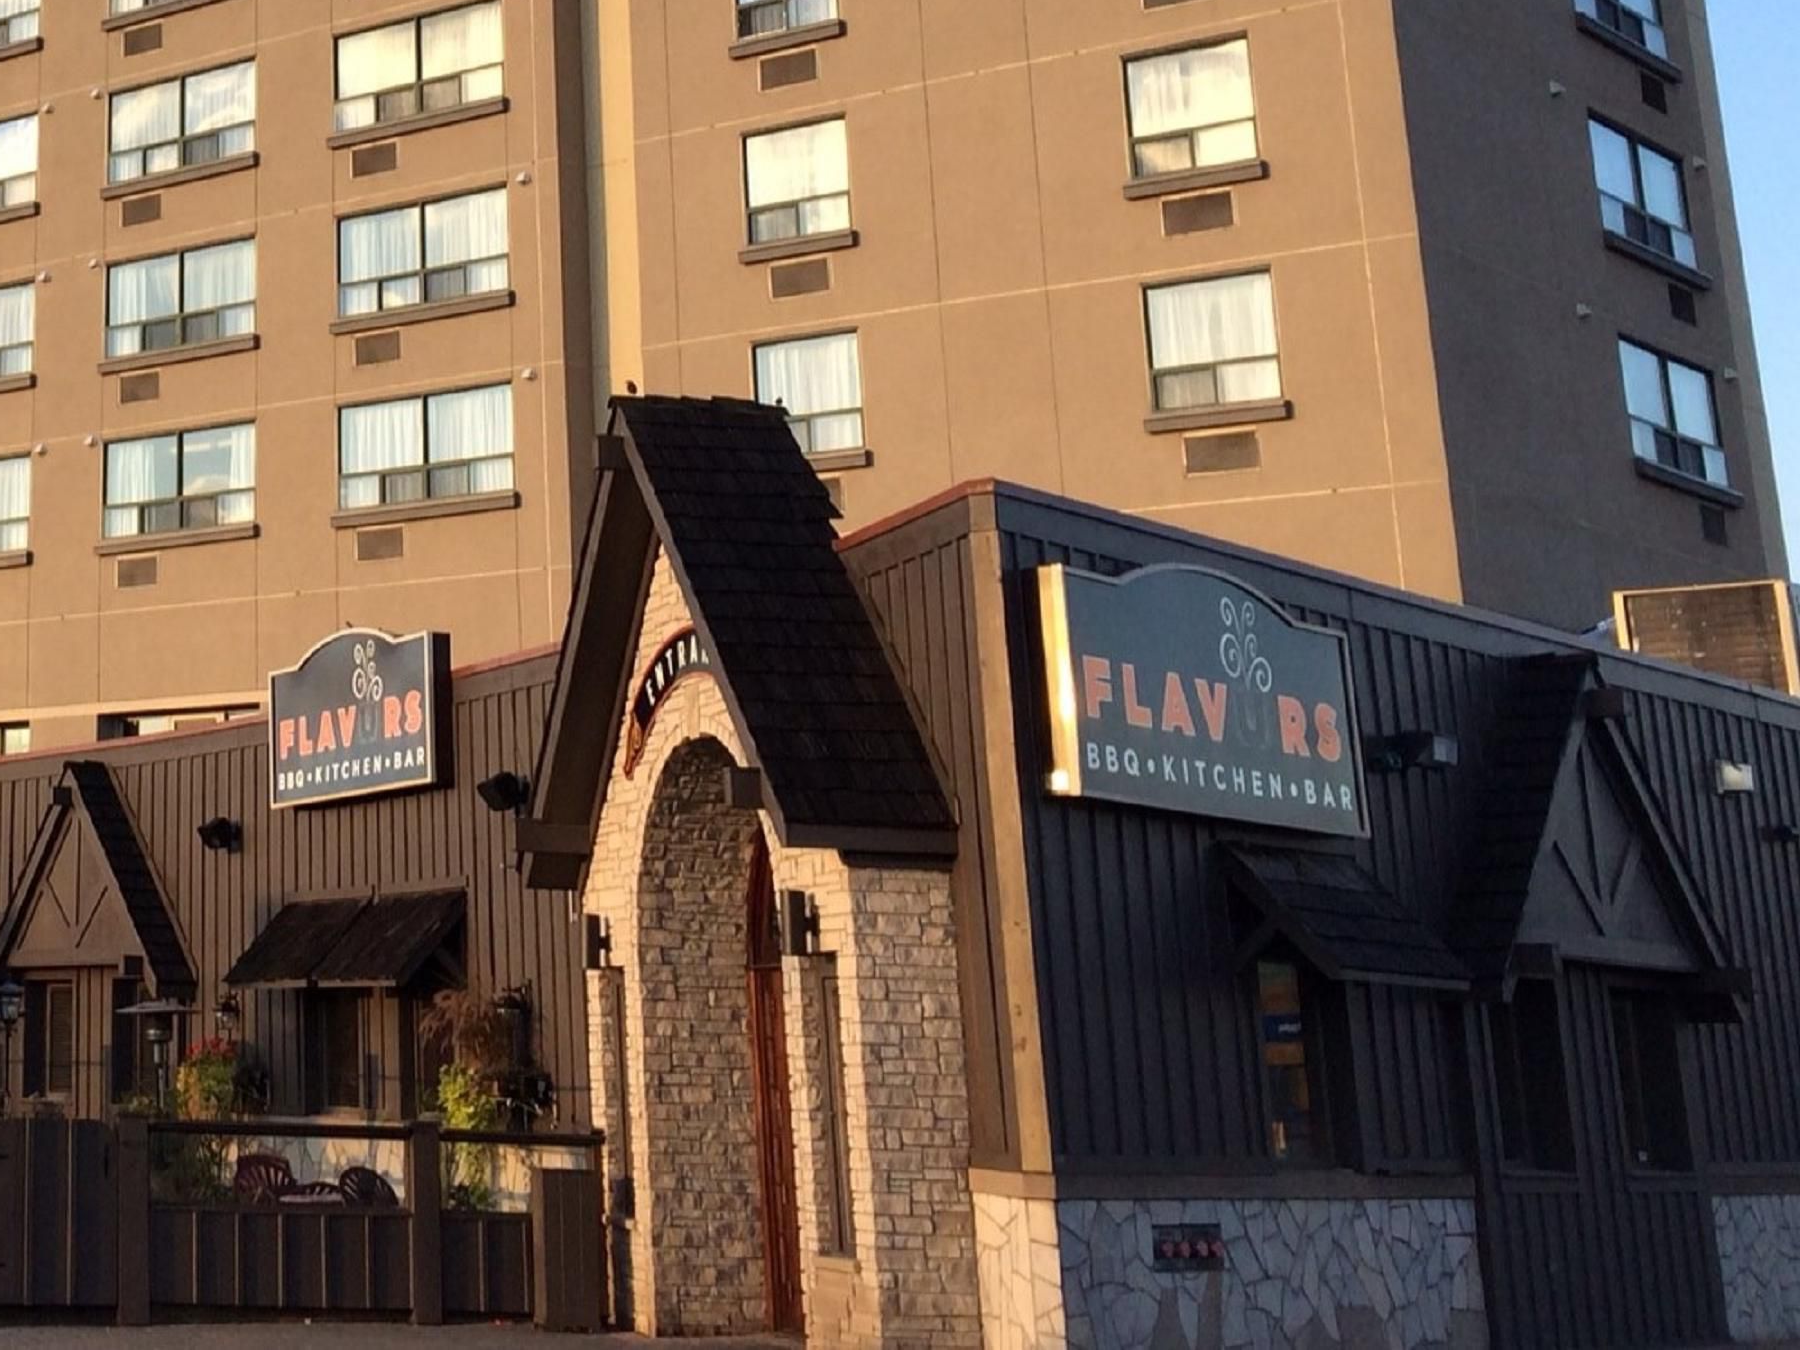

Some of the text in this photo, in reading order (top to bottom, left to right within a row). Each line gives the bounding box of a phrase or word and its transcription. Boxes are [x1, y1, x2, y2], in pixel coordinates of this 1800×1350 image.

[315, 754, 382, 785] KITCHEN
[393, 746, 425, 770] BAR
[1087, 742, 1354, 812] BBQ KITCHEN BAR
